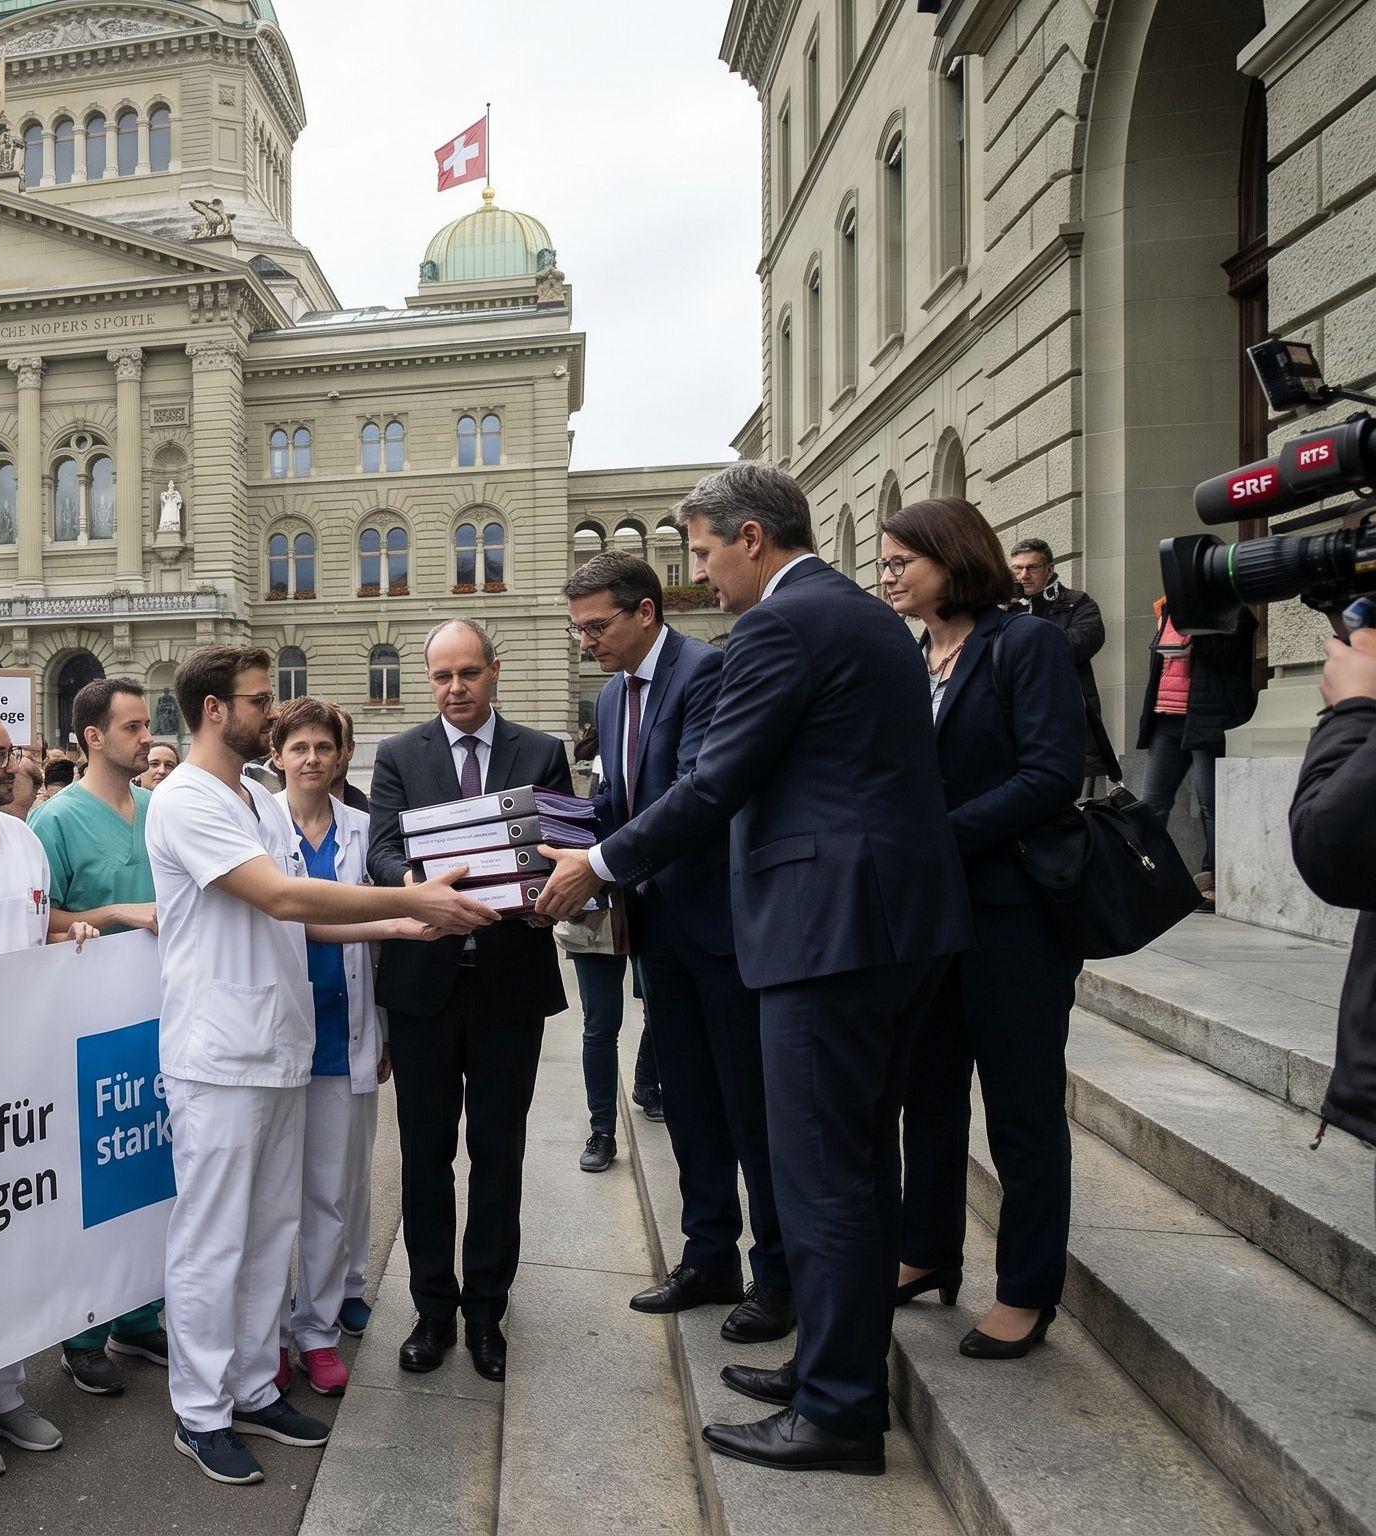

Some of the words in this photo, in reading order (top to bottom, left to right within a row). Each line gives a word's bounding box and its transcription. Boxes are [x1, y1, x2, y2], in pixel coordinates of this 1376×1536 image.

[1300, 445, 1329, 465] RTS
[1232, 474, 1272, 499] SRF
[95, 1071, 145, 1117] Für
[96, 1109, 173, 1166] stark
